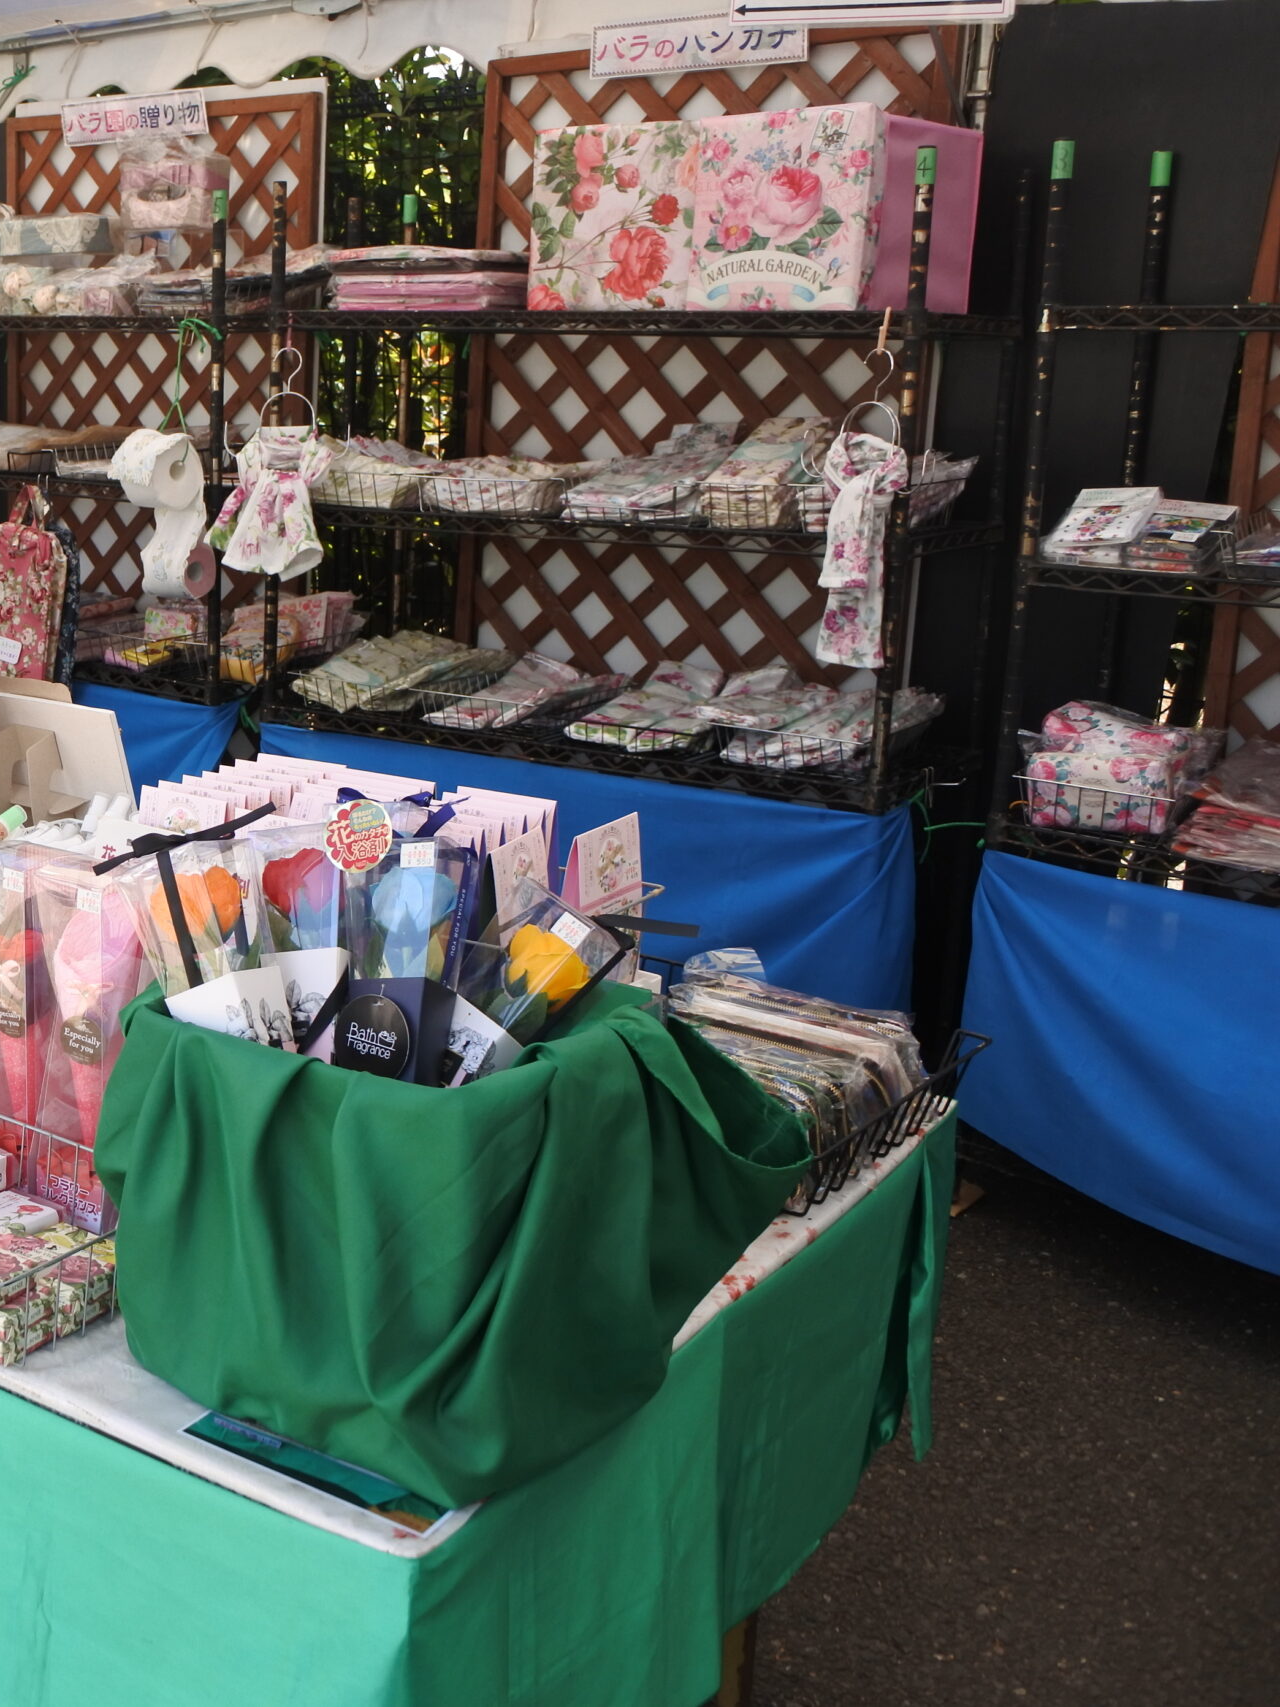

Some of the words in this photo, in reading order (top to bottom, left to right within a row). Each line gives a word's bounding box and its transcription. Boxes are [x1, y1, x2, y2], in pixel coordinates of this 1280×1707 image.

[67, 102, 200, 133] バラ園の贈り物
[917, 156, 932, 178] 4
[706, 258, 764, 285] NATURAL
[766, 258, 822, 285] GARDEN
[336, 837, 387, 862] 入浴剤
[9, 1018, 20, 1028] you
[348, 1021, 378, 1045] Bath
[63, 1027, 102, 1048] Especially
[68, 1038, 80, 1048] for
[80, 1043, 94, 1054] you
[347, 1035, 391, 1060] Fragrance
[49, 1174, 90, 1197] フラワー
